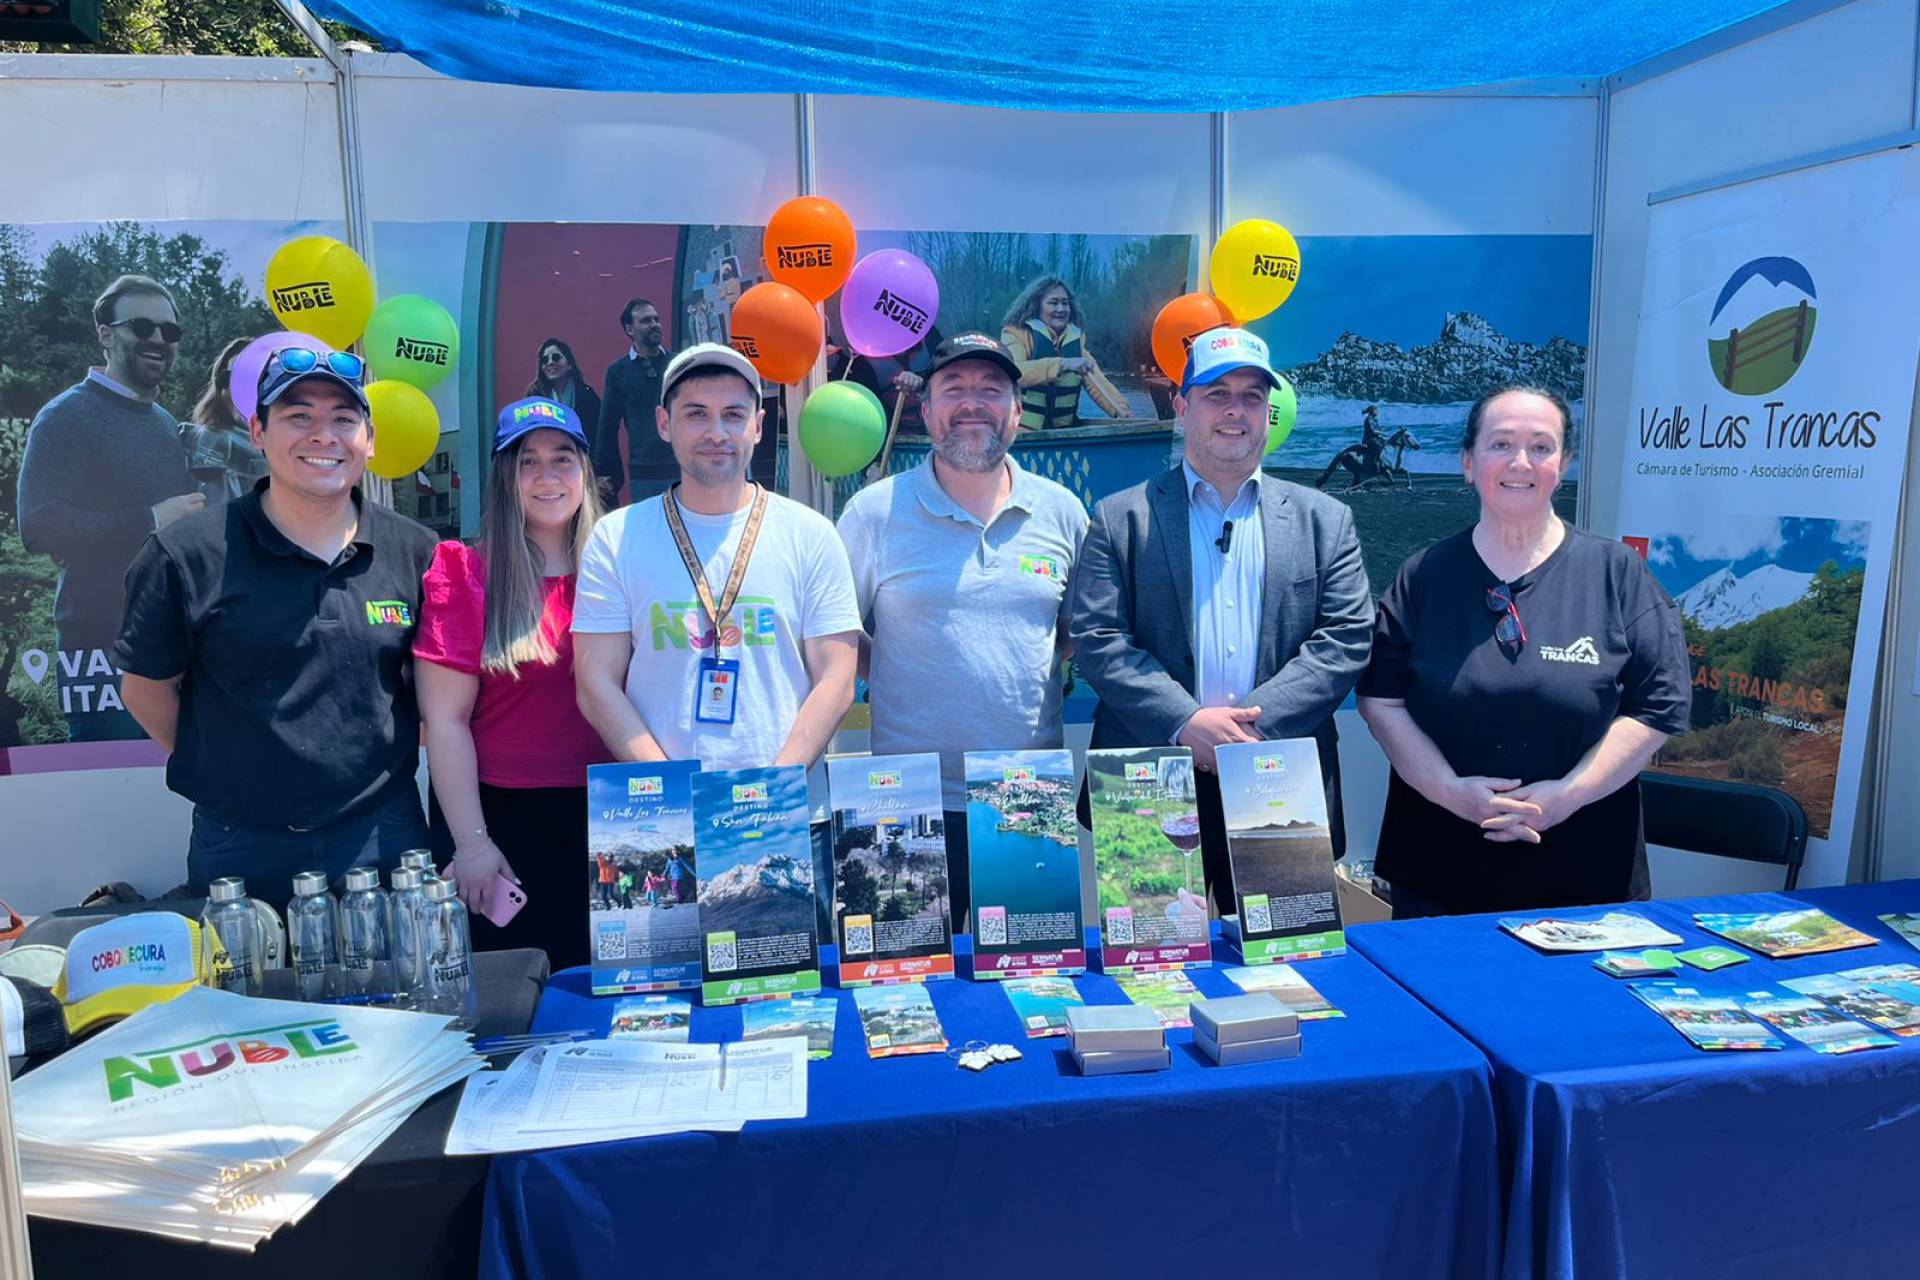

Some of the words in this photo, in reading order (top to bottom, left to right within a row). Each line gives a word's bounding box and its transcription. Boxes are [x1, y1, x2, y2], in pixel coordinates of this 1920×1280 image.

[1640, 406, 1691, 450] Valle
[1700, 404, 1750, 449] Las
[1763, 402, 1881, 450] Trancas
[1637, 462, 1677, 476] Cámara
[1680, 463, 1692, 476] de
[1695, 463, 1739, 477] Turismo
[1750, 463, 1809, 478] Asociación
[1812, 465, 1865, 479] Gremial
[58, 649, 124, 677] VA
[1540, 650, 1600, 665] TRANCAS
[1689, 665, 1721, 690] AS
[1728, 671, 1826, 713] TRANCAS
[1793, 719, 1819, 734] LOCAL
